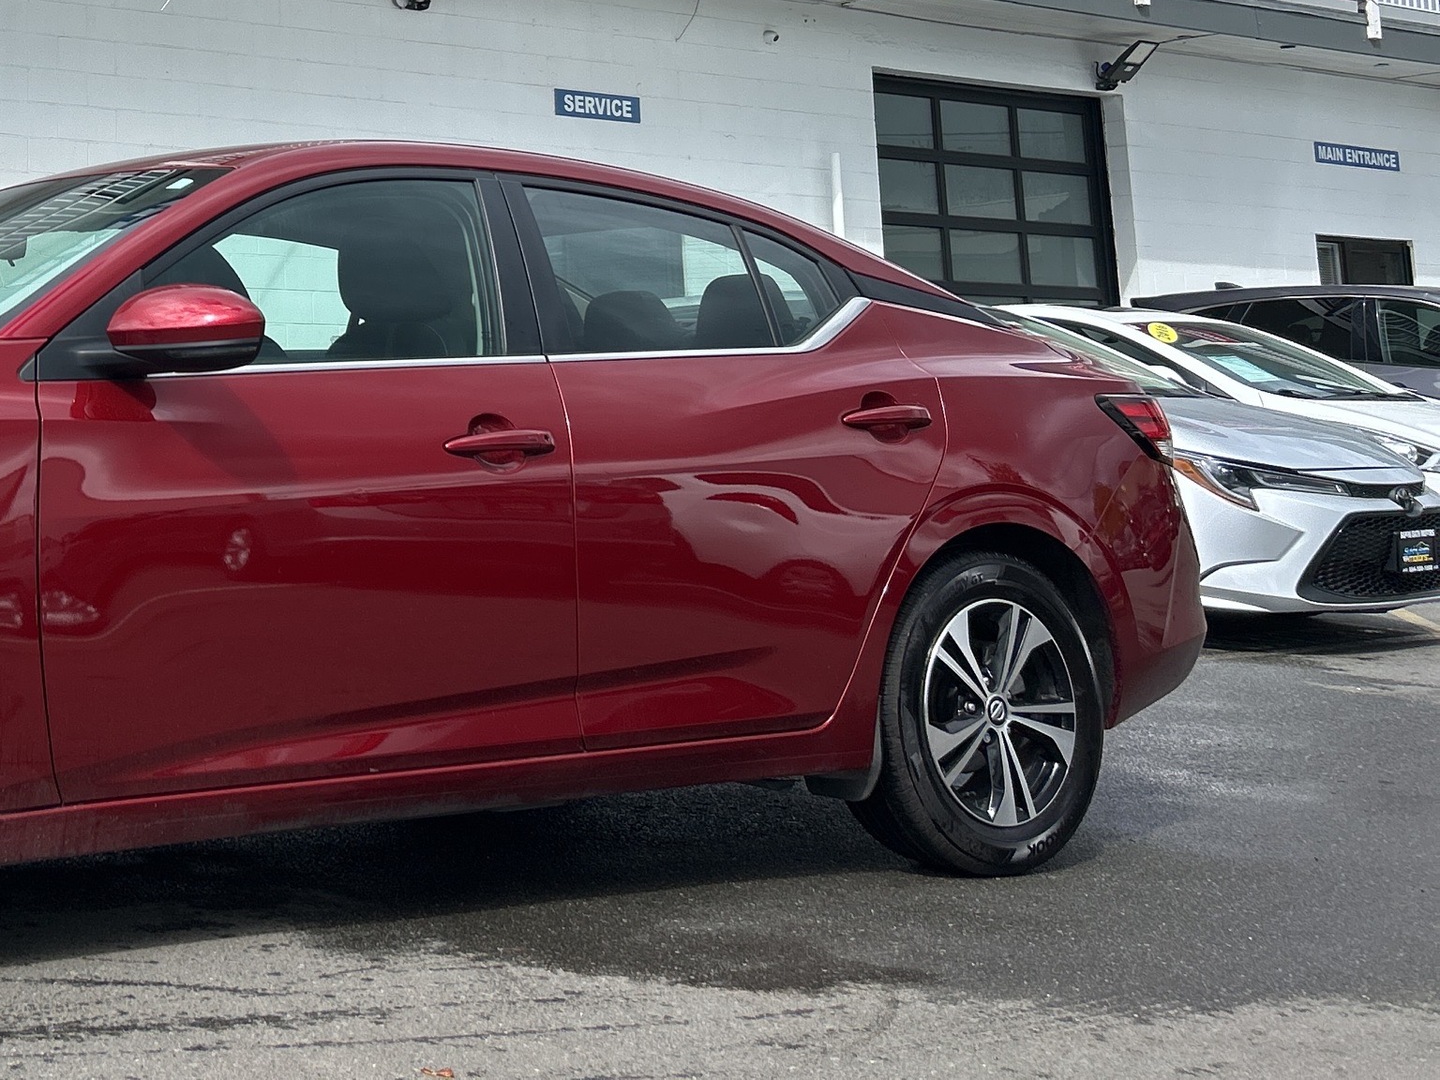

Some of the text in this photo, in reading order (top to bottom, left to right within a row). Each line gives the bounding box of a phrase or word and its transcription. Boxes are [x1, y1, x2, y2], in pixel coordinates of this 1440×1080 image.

[563, 94, 632, 118] SERVICE
[1318, 145, 1396, 167] MAIN ENTRANCE
